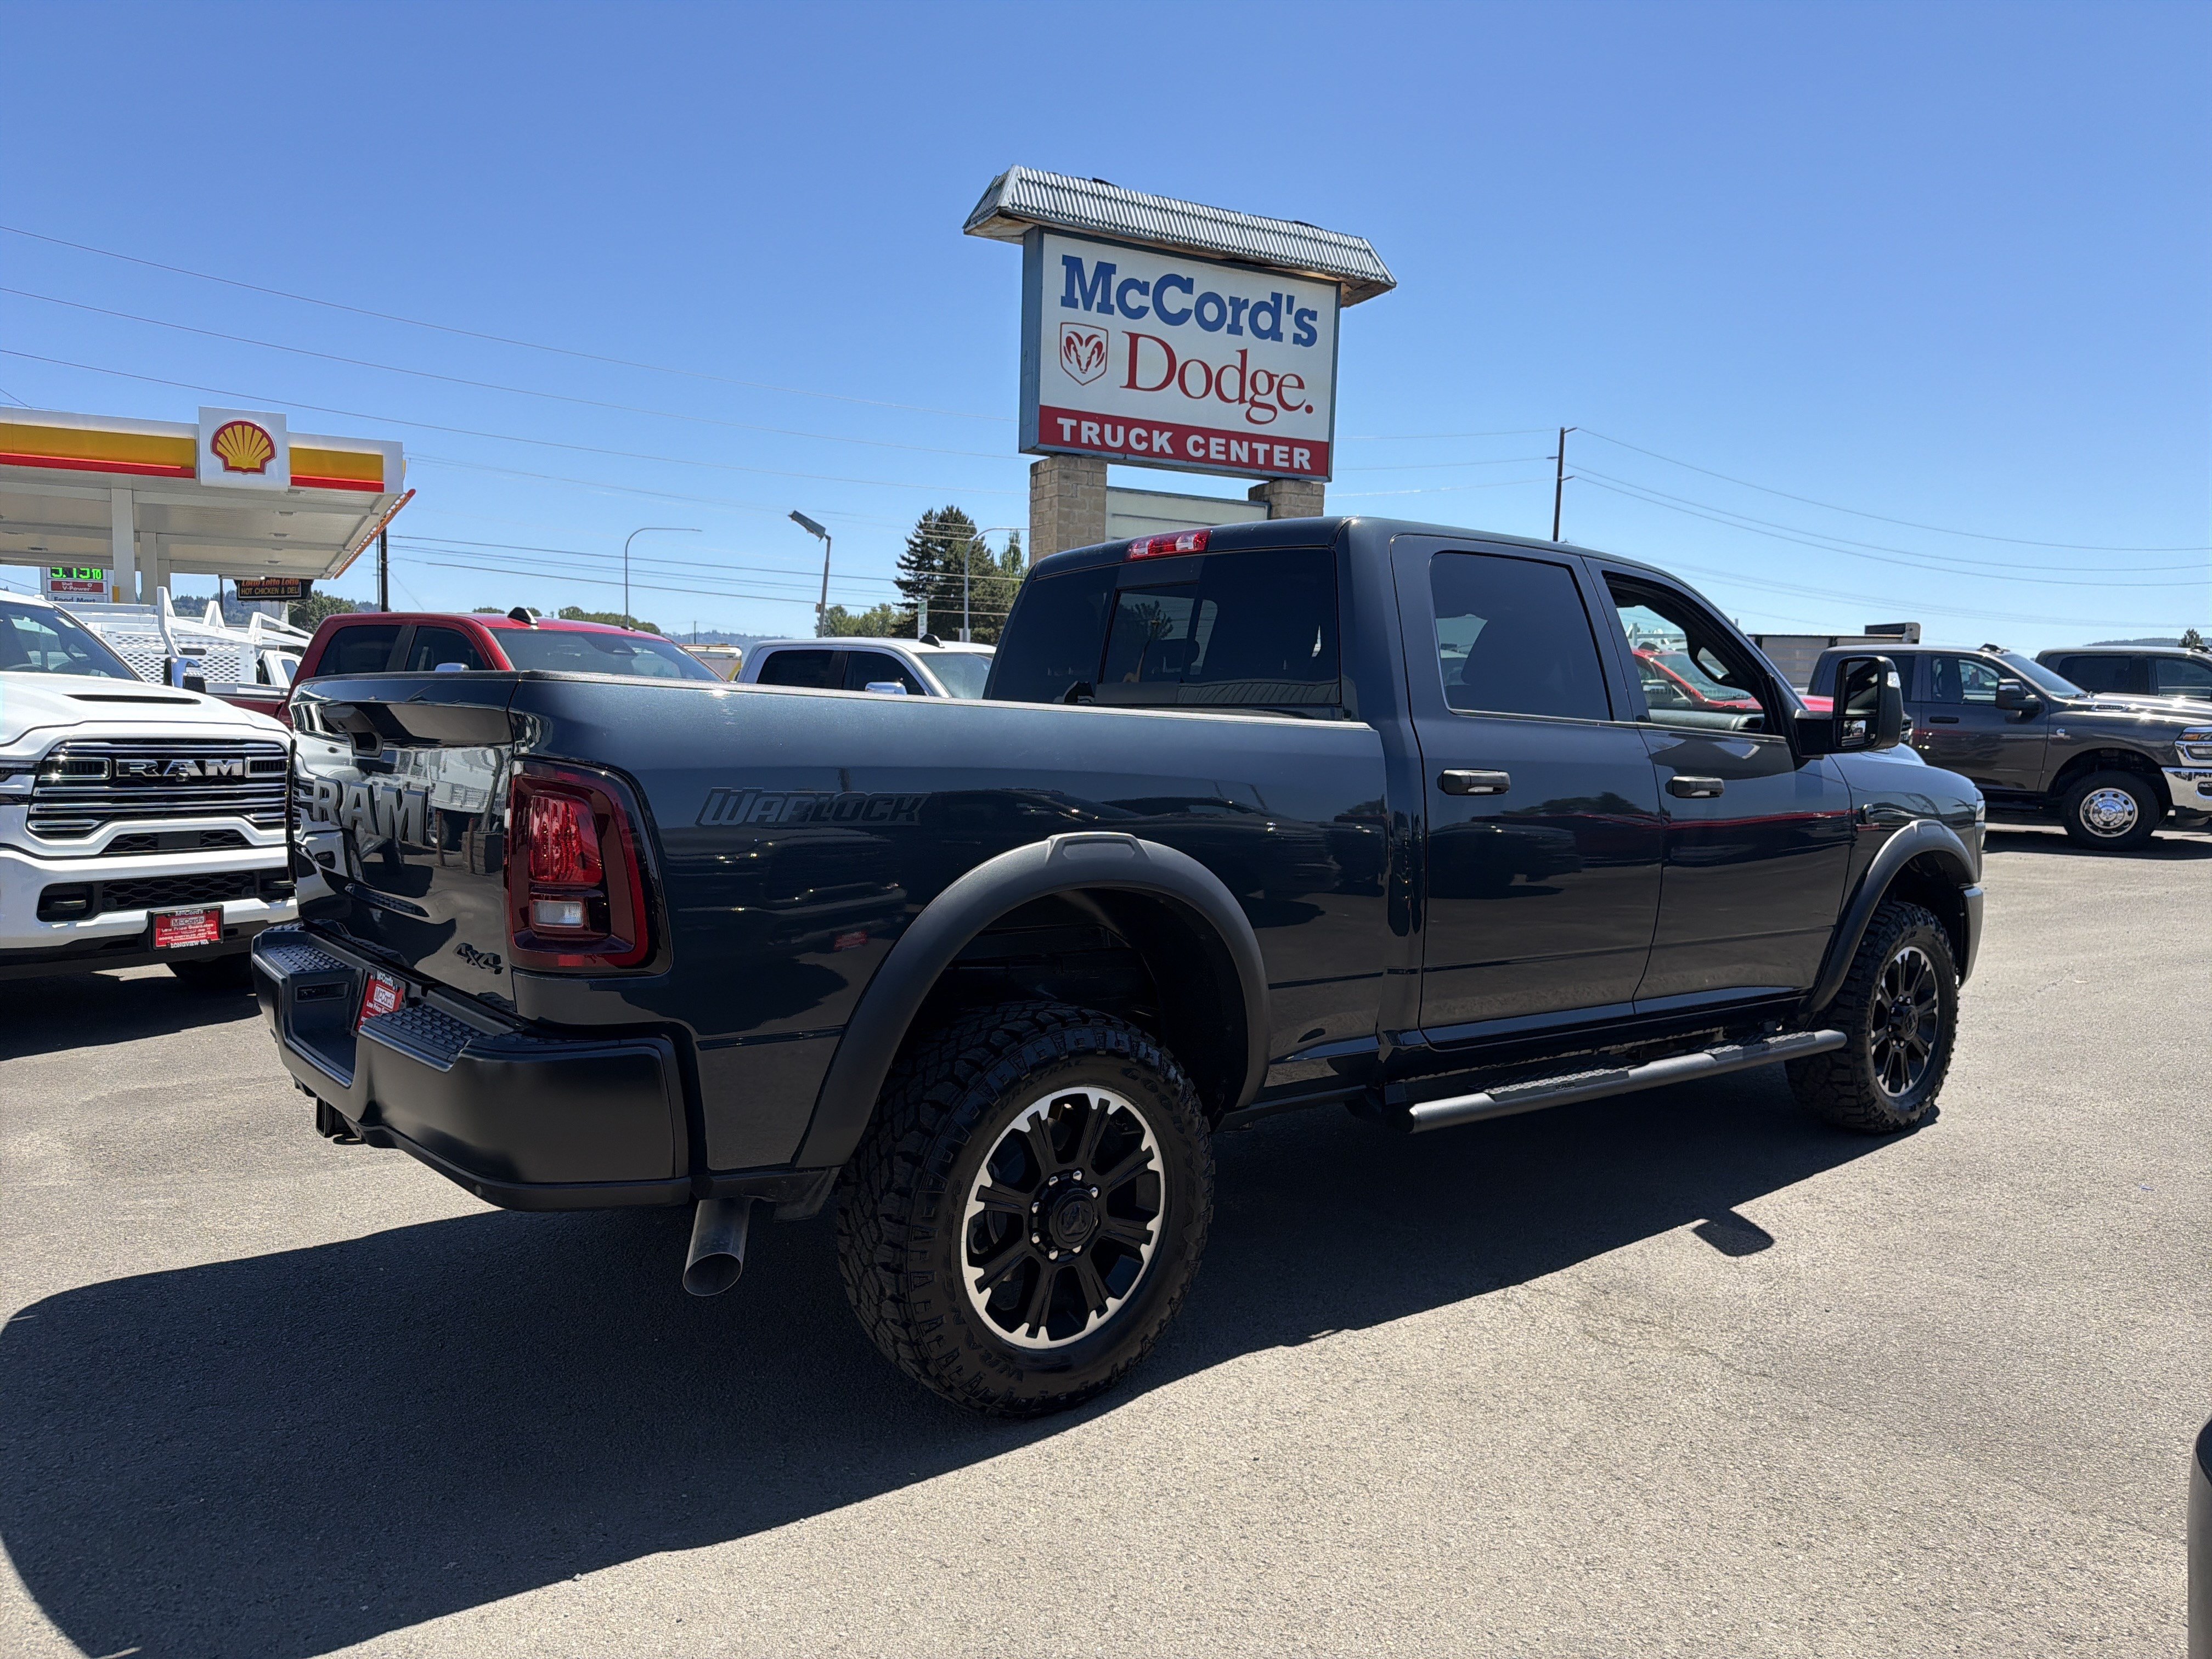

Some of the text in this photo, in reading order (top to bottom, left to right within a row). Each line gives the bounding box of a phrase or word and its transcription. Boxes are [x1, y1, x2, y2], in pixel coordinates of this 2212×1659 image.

[1060, 254, 1318, 348] McCord's
[1119, 330, 1313, 425] Dodge.
[1057, 417, 1312, 470] TRUCK CENTER
[241, 587, 253, 595] HOT
[254, 586, 279, 595] CHICKEN
[116, 758, 244, 777] RAM
[312, 776, 429, 846] RAM
[173, 917, 204, 926] McCord's
[171, 939, 200, 949] LONGVIEW
